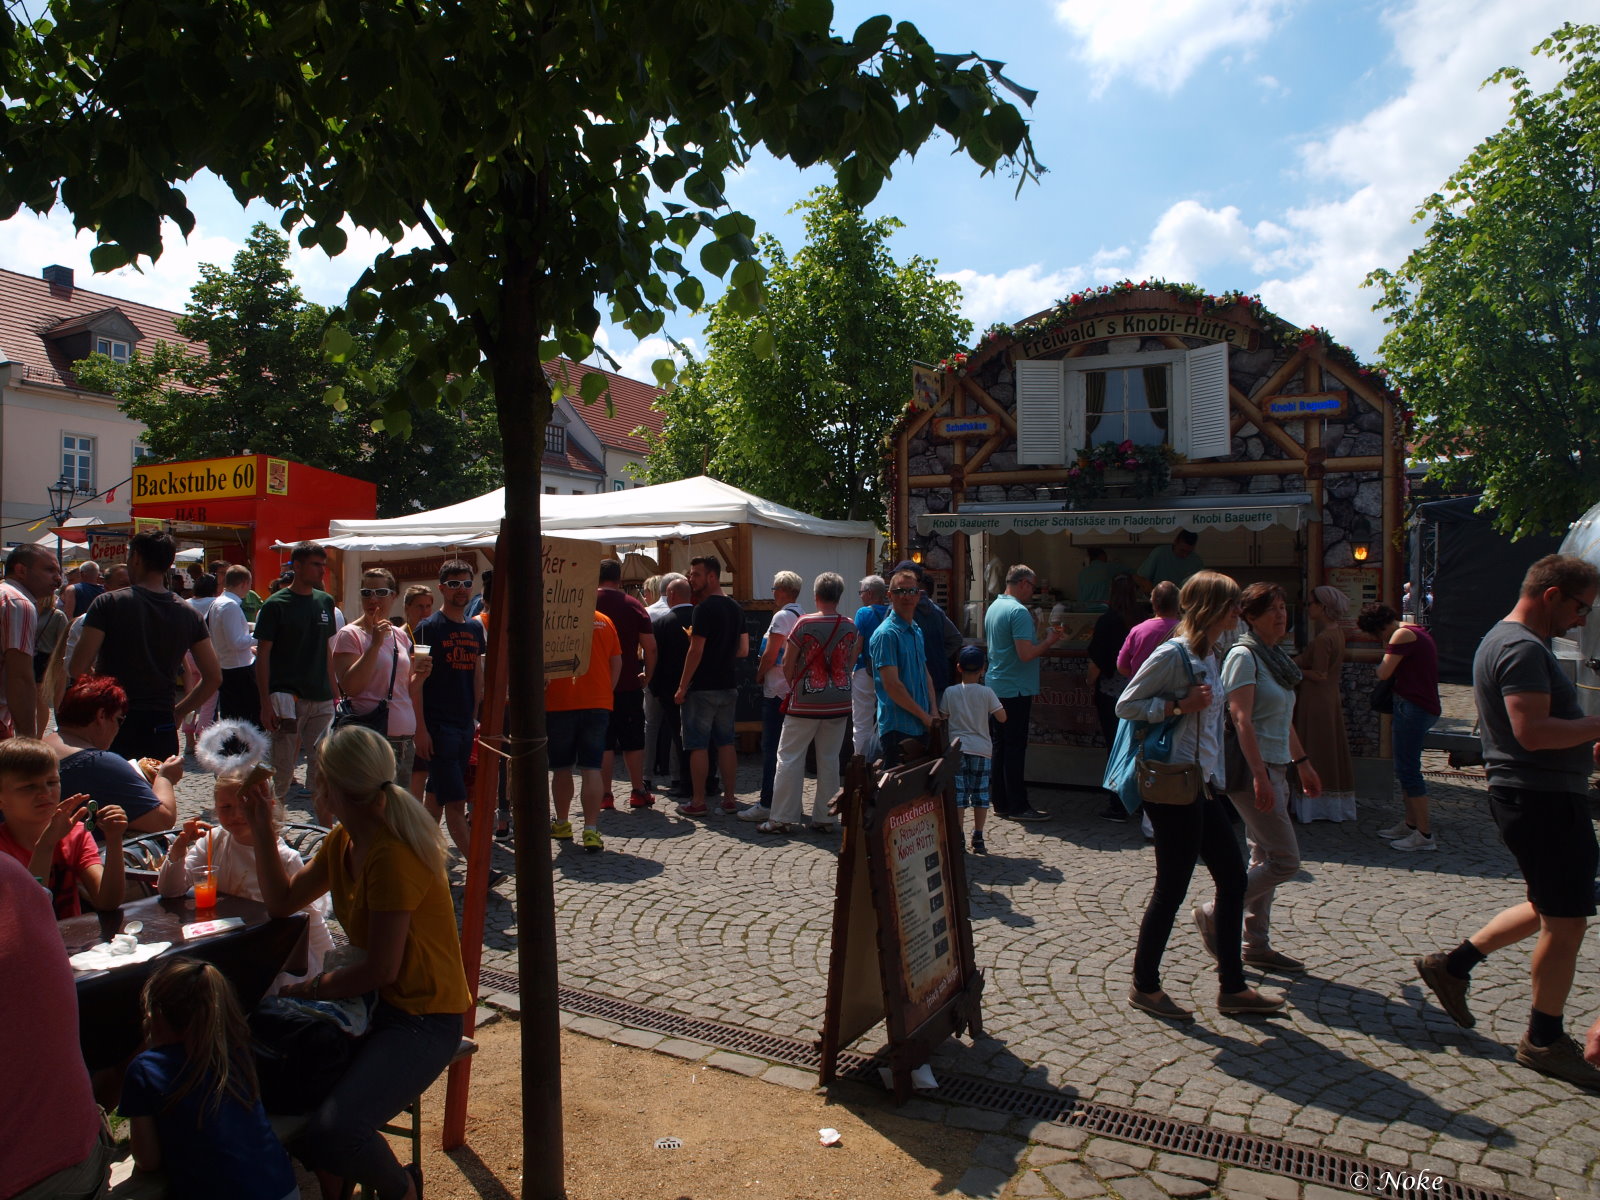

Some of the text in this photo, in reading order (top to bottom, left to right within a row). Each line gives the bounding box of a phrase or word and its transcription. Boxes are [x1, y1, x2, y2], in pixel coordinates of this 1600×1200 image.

[1123, 315, 1236, 342] Knobi-Hütte
[136, 463, 254, 497] Backstube 60
[933, 512, 1272, 529] Knobi Baguette frischer Schafskäse im Fladenbrot Knobi Baguette
[92, 543, 127, 560] Crêpes
[889, 800, 935, 830] Bruschetta
